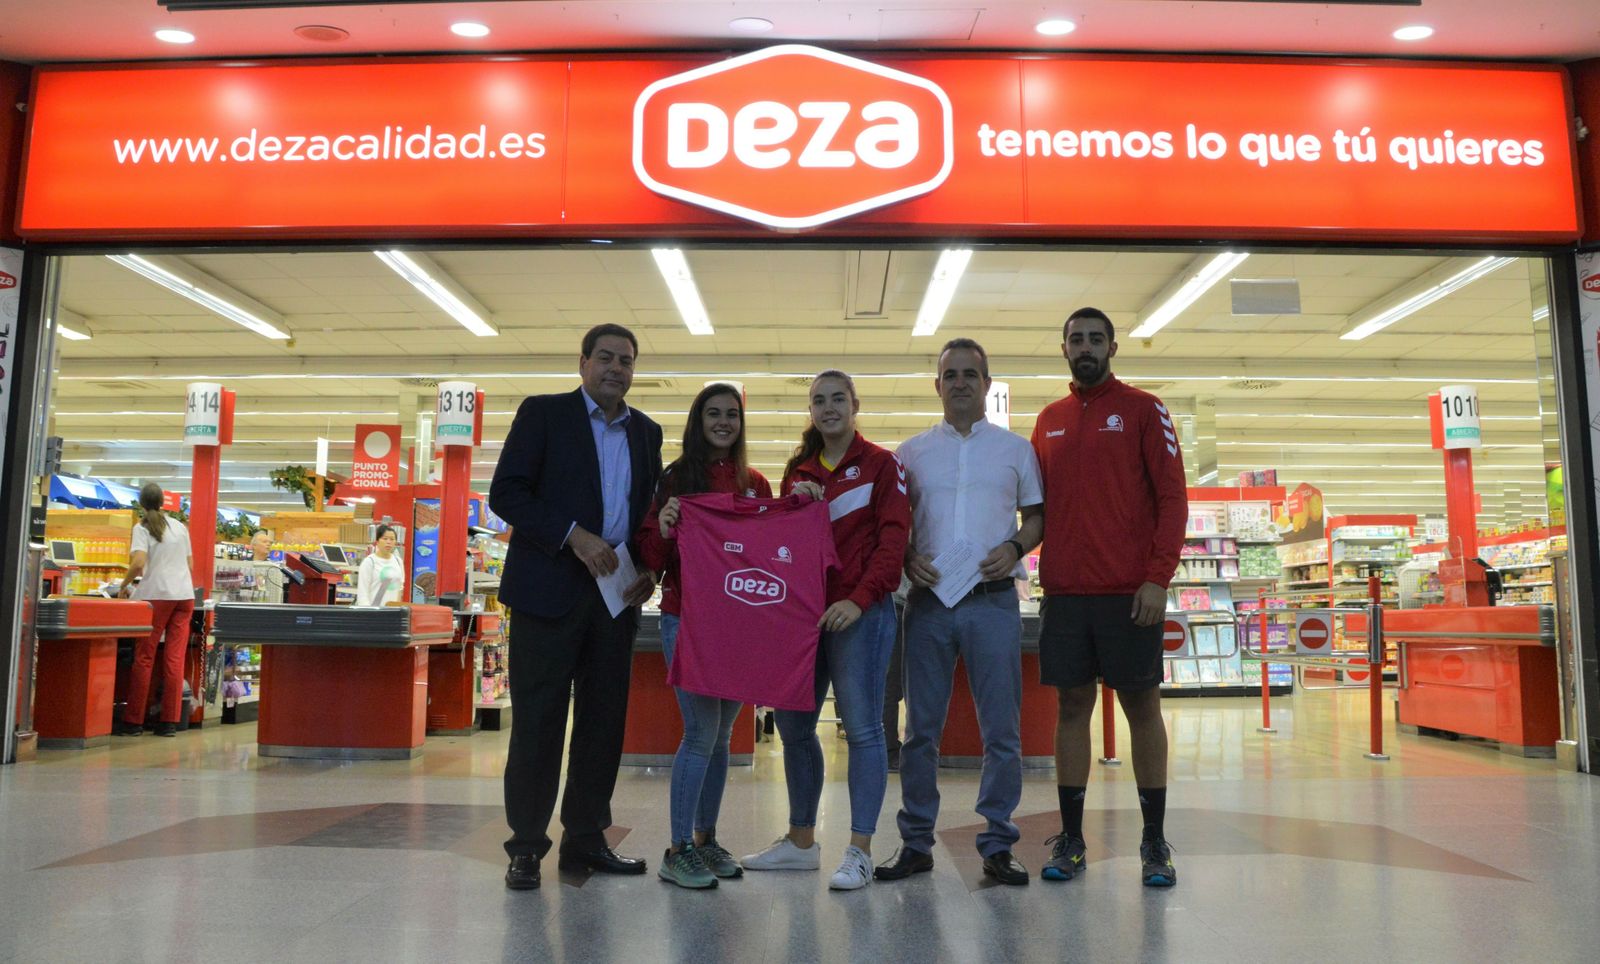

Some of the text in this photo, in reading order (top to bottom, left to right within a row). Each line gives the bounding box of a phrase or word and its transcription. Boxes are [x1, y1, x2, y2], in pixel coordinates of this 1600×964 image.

[112, 124, 548, 164] www.dezacalidad.es
[666, 99, 920, 170] Deza
[977, 123, 1545, 172] tenemos lo que tú quieres
[200, 391, 219, 413] 14
[439, 390, 475, 413] 13 13
[994, 391, 1008, 414] 11
[1442, 395, 1463, 418] 10
[353, 470, 393, 480] PROMO-
[354, 462, 388, 470] PUNTO
[352, 479, 391, 488] CIONAL
[731, 576, 780, 597] Deza
